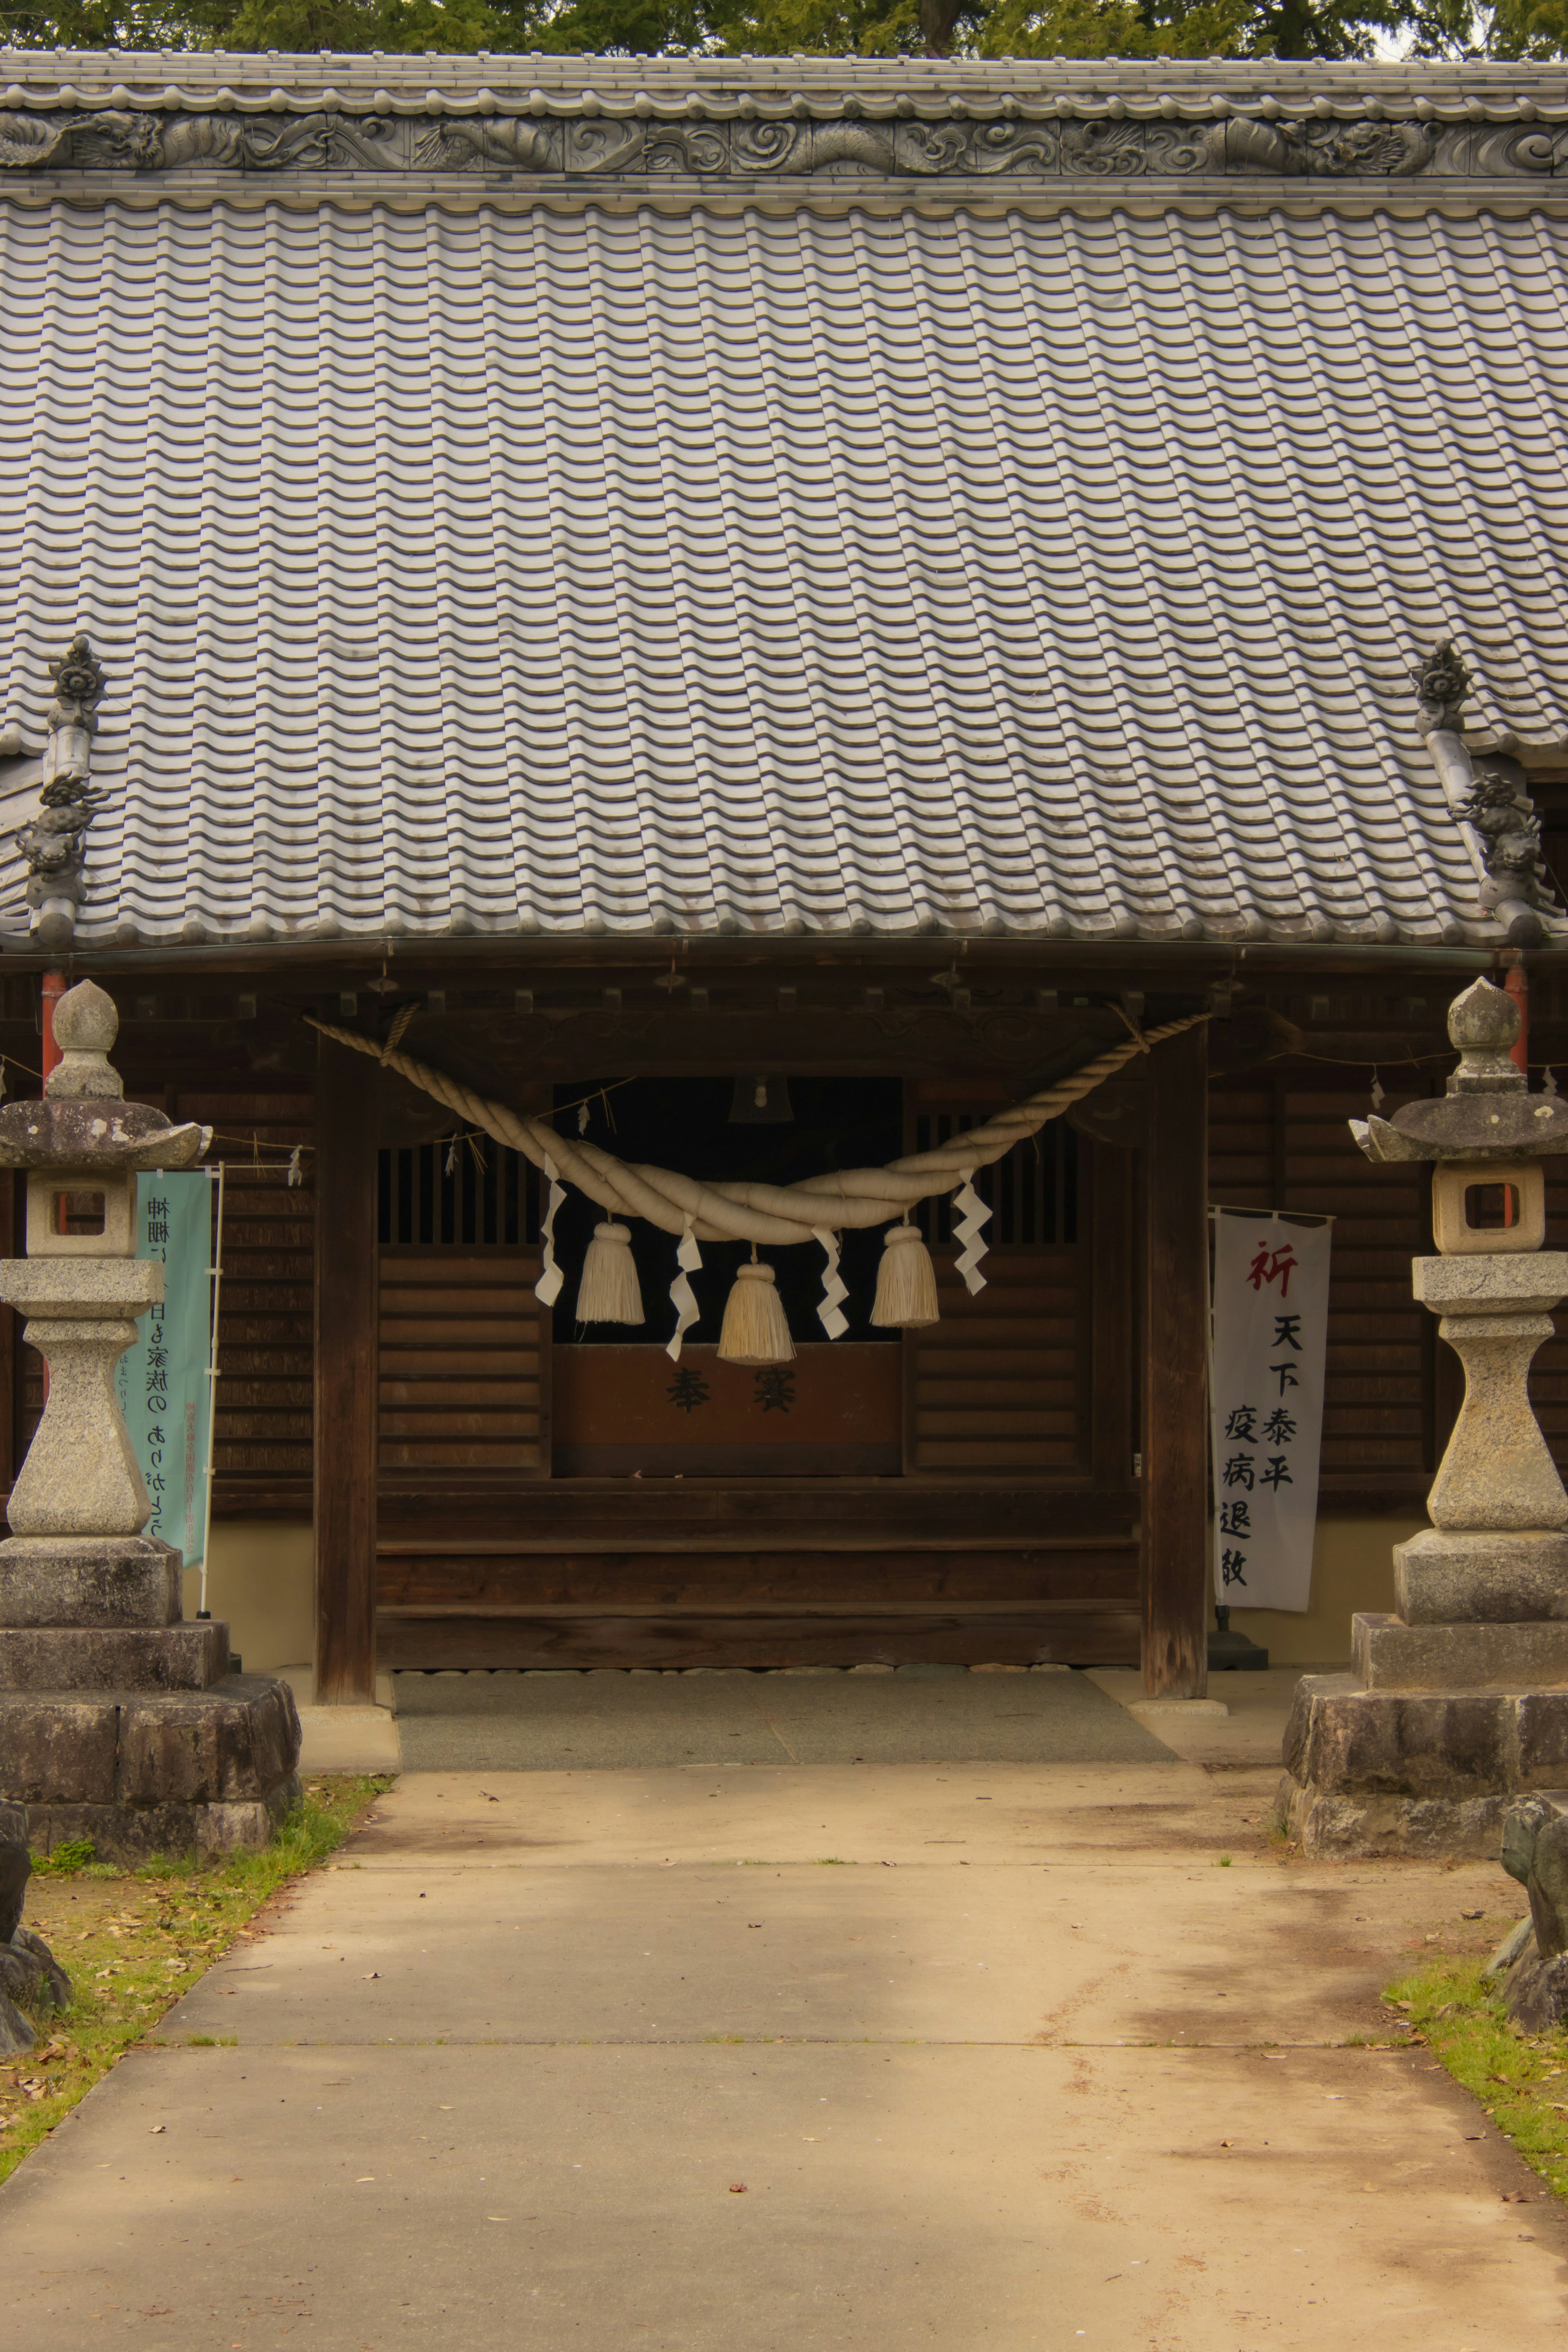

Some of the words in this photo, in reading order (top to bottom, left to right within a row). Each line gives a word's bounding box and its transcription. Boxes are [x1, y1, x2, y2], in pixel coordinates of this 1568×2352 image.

[1245, 1241, 1299, 1298] 祈
[1259, 1315, 1303, 1493] 天下泰平
[1220, 1404, 1259, 1587] 疫病退散
